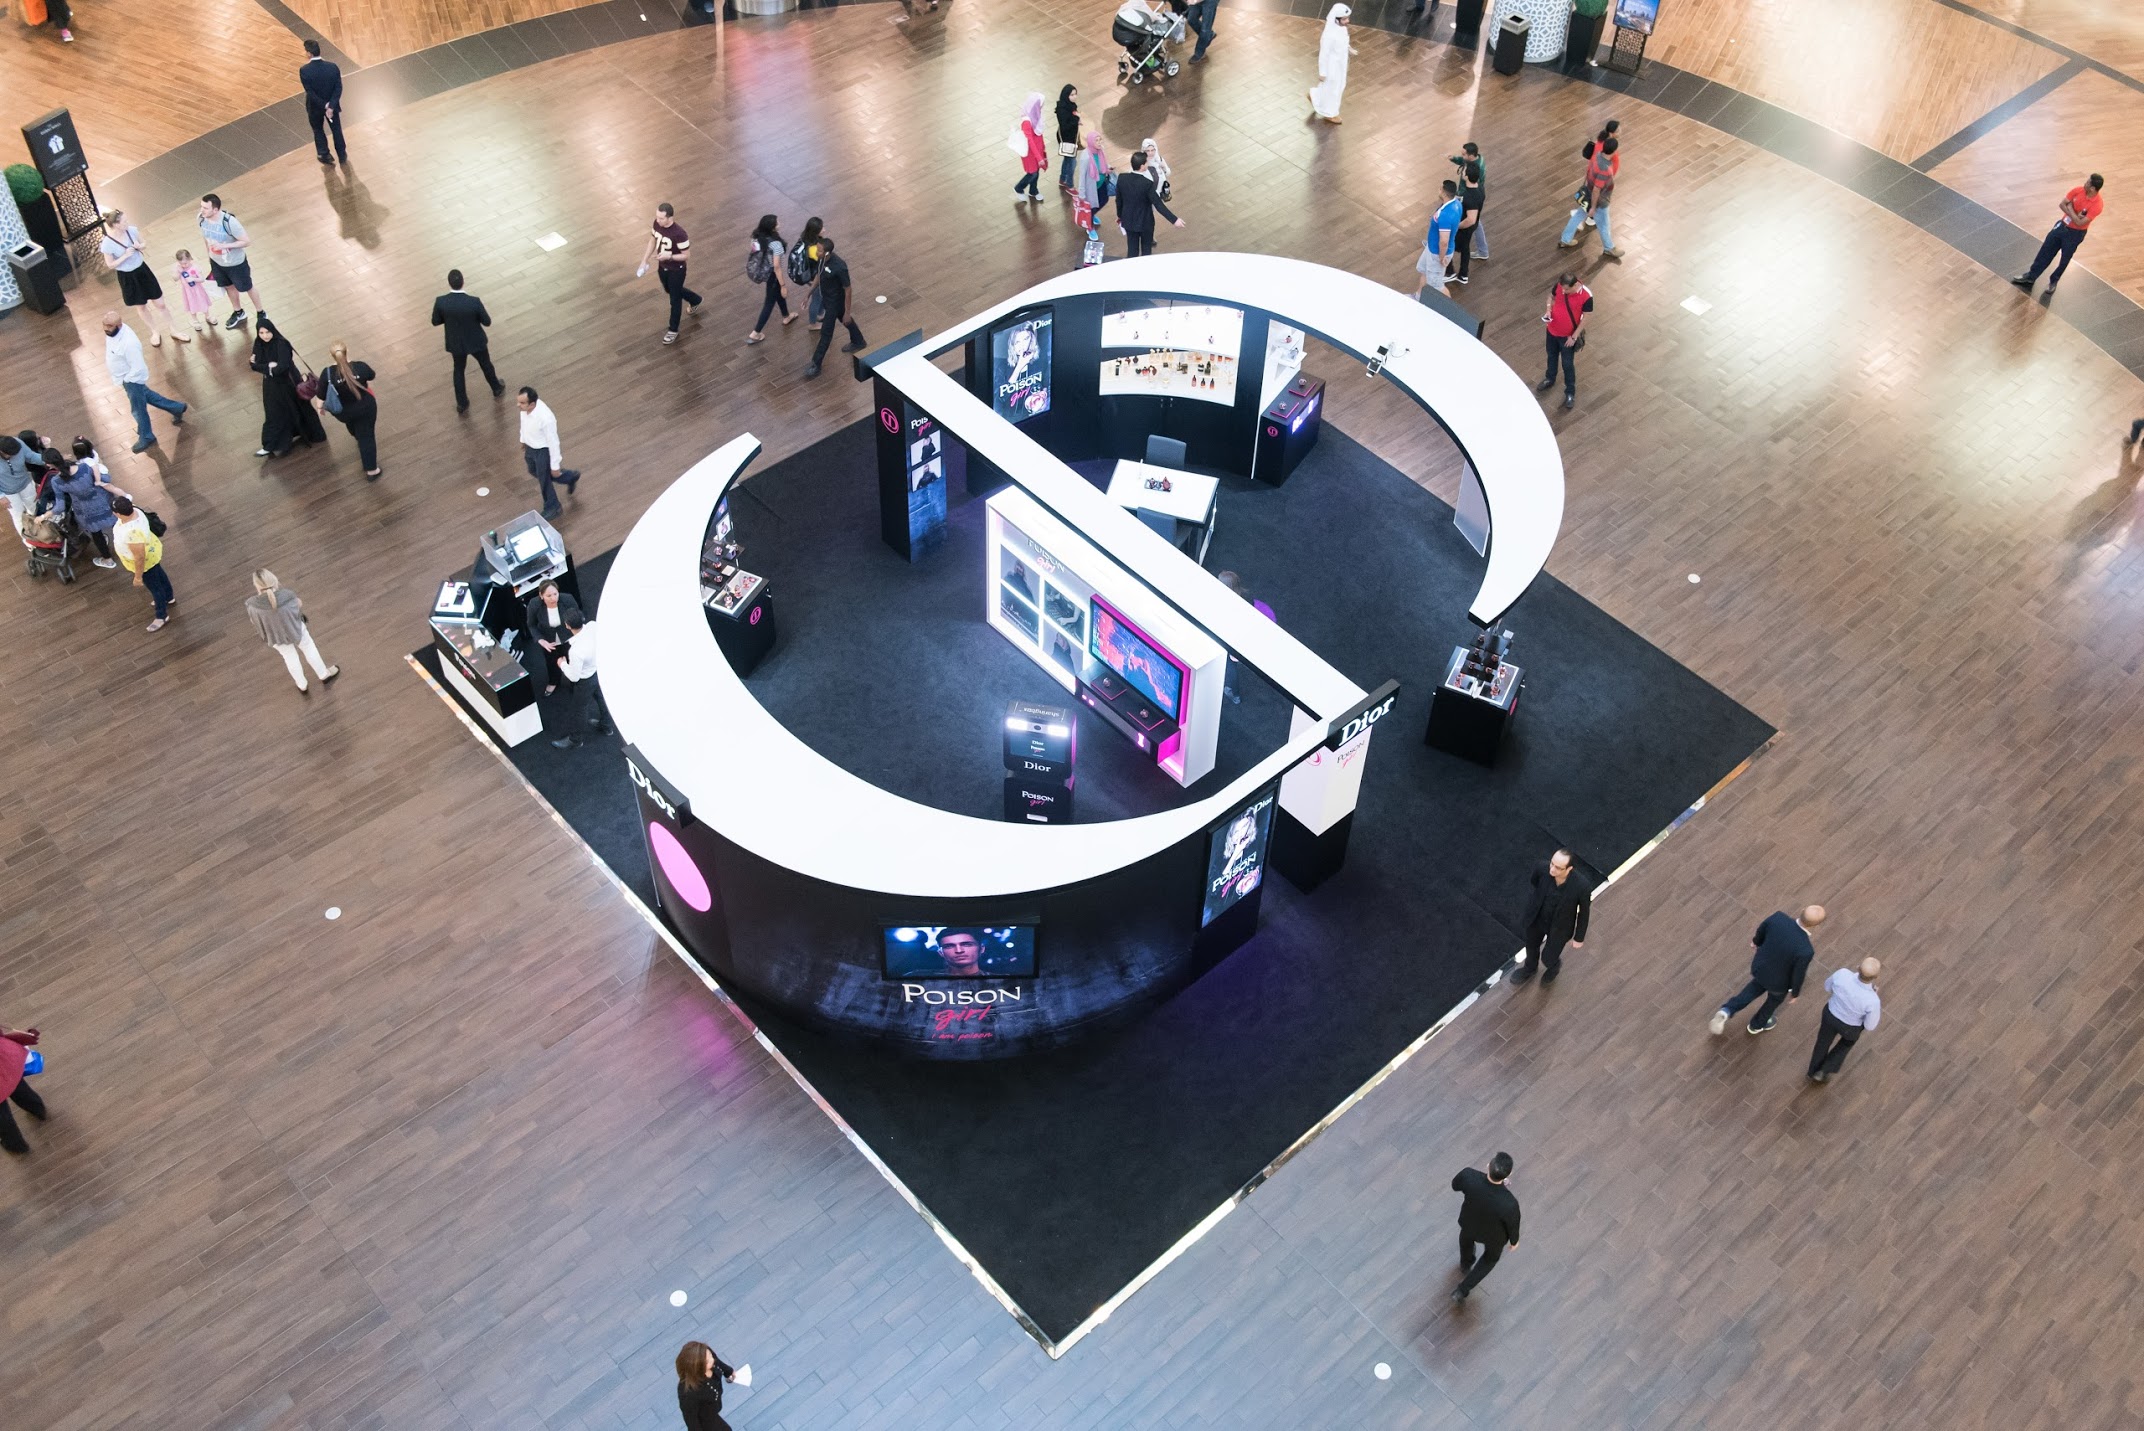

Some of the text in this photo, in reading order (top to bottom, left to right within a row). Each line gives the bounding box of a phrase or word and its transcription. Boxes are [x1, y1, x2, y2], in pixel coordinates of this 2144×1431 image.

[654, 231, 673, 257] 72
[1033, 319, 1053, 330] Dior
[1000, 372, 1043, 398] POISON
[1338, 696, 1395, 747] Dior
[1023, 761, 1052, 773] Dior
[625, 756, 676, 820] Dior
[1021, 790, 1054, 803] POISON
[1253, 796, 1274, 815] Dior
[1212, 851, 1257, 893] POISON
[901, 983, 1021, 1005] POISON
[935, 1004, 992, 1031] girl
[957, 1032, 993, 1041] poison
